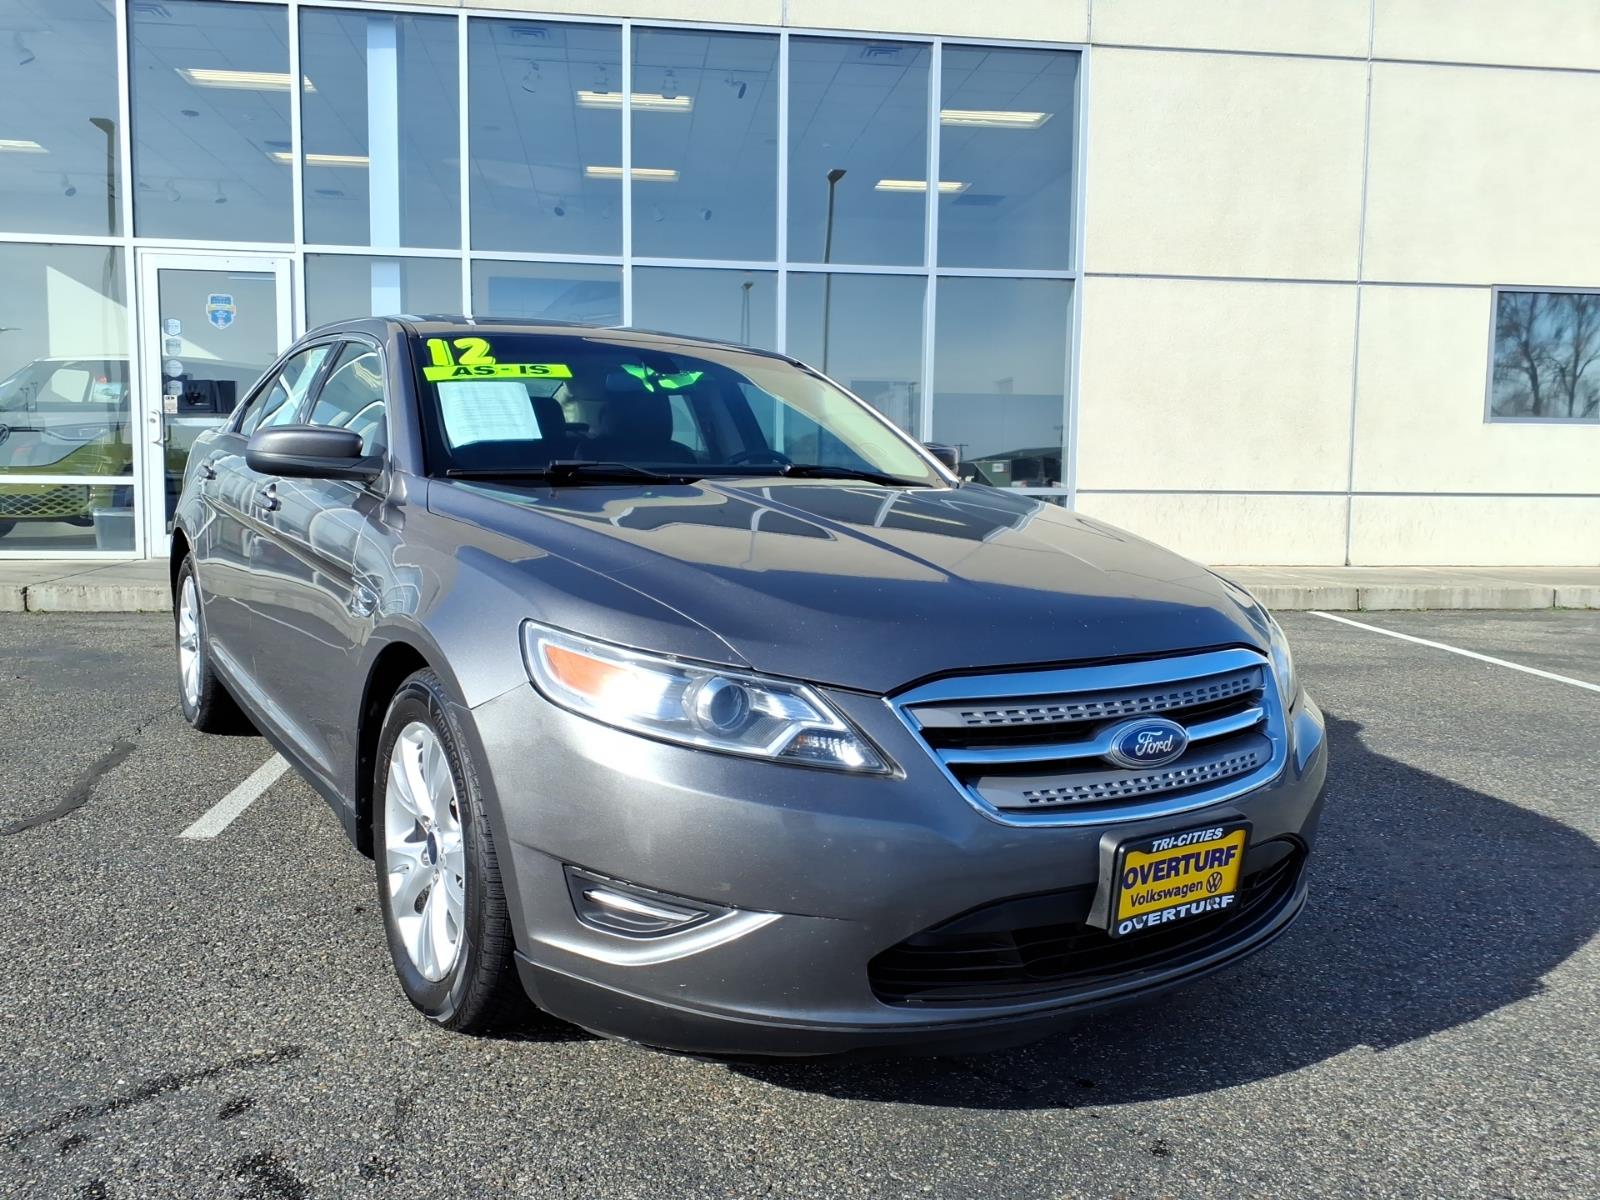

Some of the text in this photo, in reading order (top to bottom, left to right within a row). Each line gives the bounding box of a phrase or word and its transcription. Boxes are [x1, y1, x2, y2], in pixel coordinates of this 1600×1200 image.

[427, 337, 496, 366] 12
[1135, 730, 1174, 756] Ford
[1152, 827, 1224, 852] TRI-CITIES
[1122, 845, 1238, 890] OVERTURF
[1130, 880, 1203, 908] Volkswagen
[1118, 895, 1235, 935] OVERTURF
